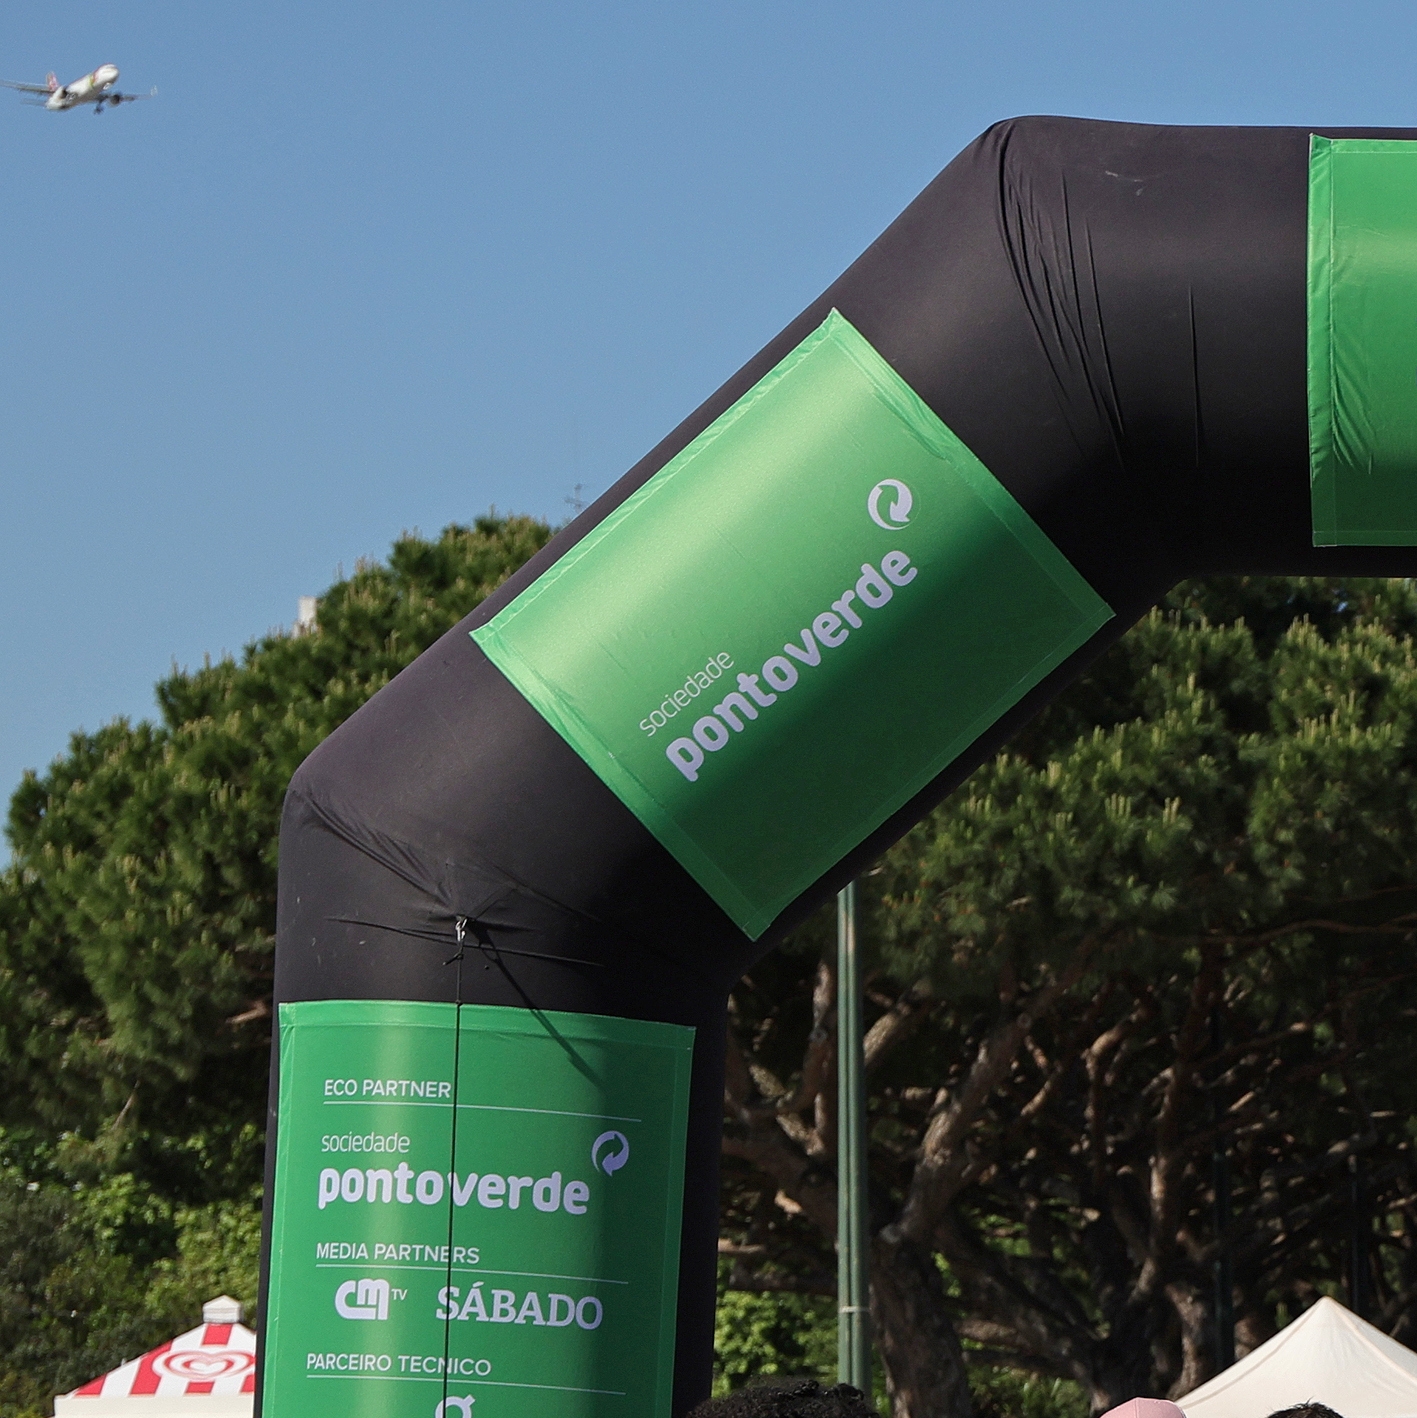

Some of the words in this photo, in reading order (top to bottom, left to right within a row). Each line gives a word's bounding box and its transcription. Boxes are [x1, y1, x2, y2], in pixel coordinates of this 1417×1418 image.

[666, 550, 918, 782] pontoverde
[639, 651, 734, 736] sociedade
[324, 1079, 357, 1096] ECO
[362, 1080, 451, 1098] PARTNER
[321, 1132, 410, 1152] sociedade
[318, 1163, 589, 1215] pontoverde
[316, 1243, 368, 1259] MEDIA
[374, 1244, 480, 1264] PARTNERS
[436, 1282, 603, 1330] SÁBADO
[307, 1353, 391, 1371] PARCEIRO
[399, 1356, 492, 1375] TECNICO
